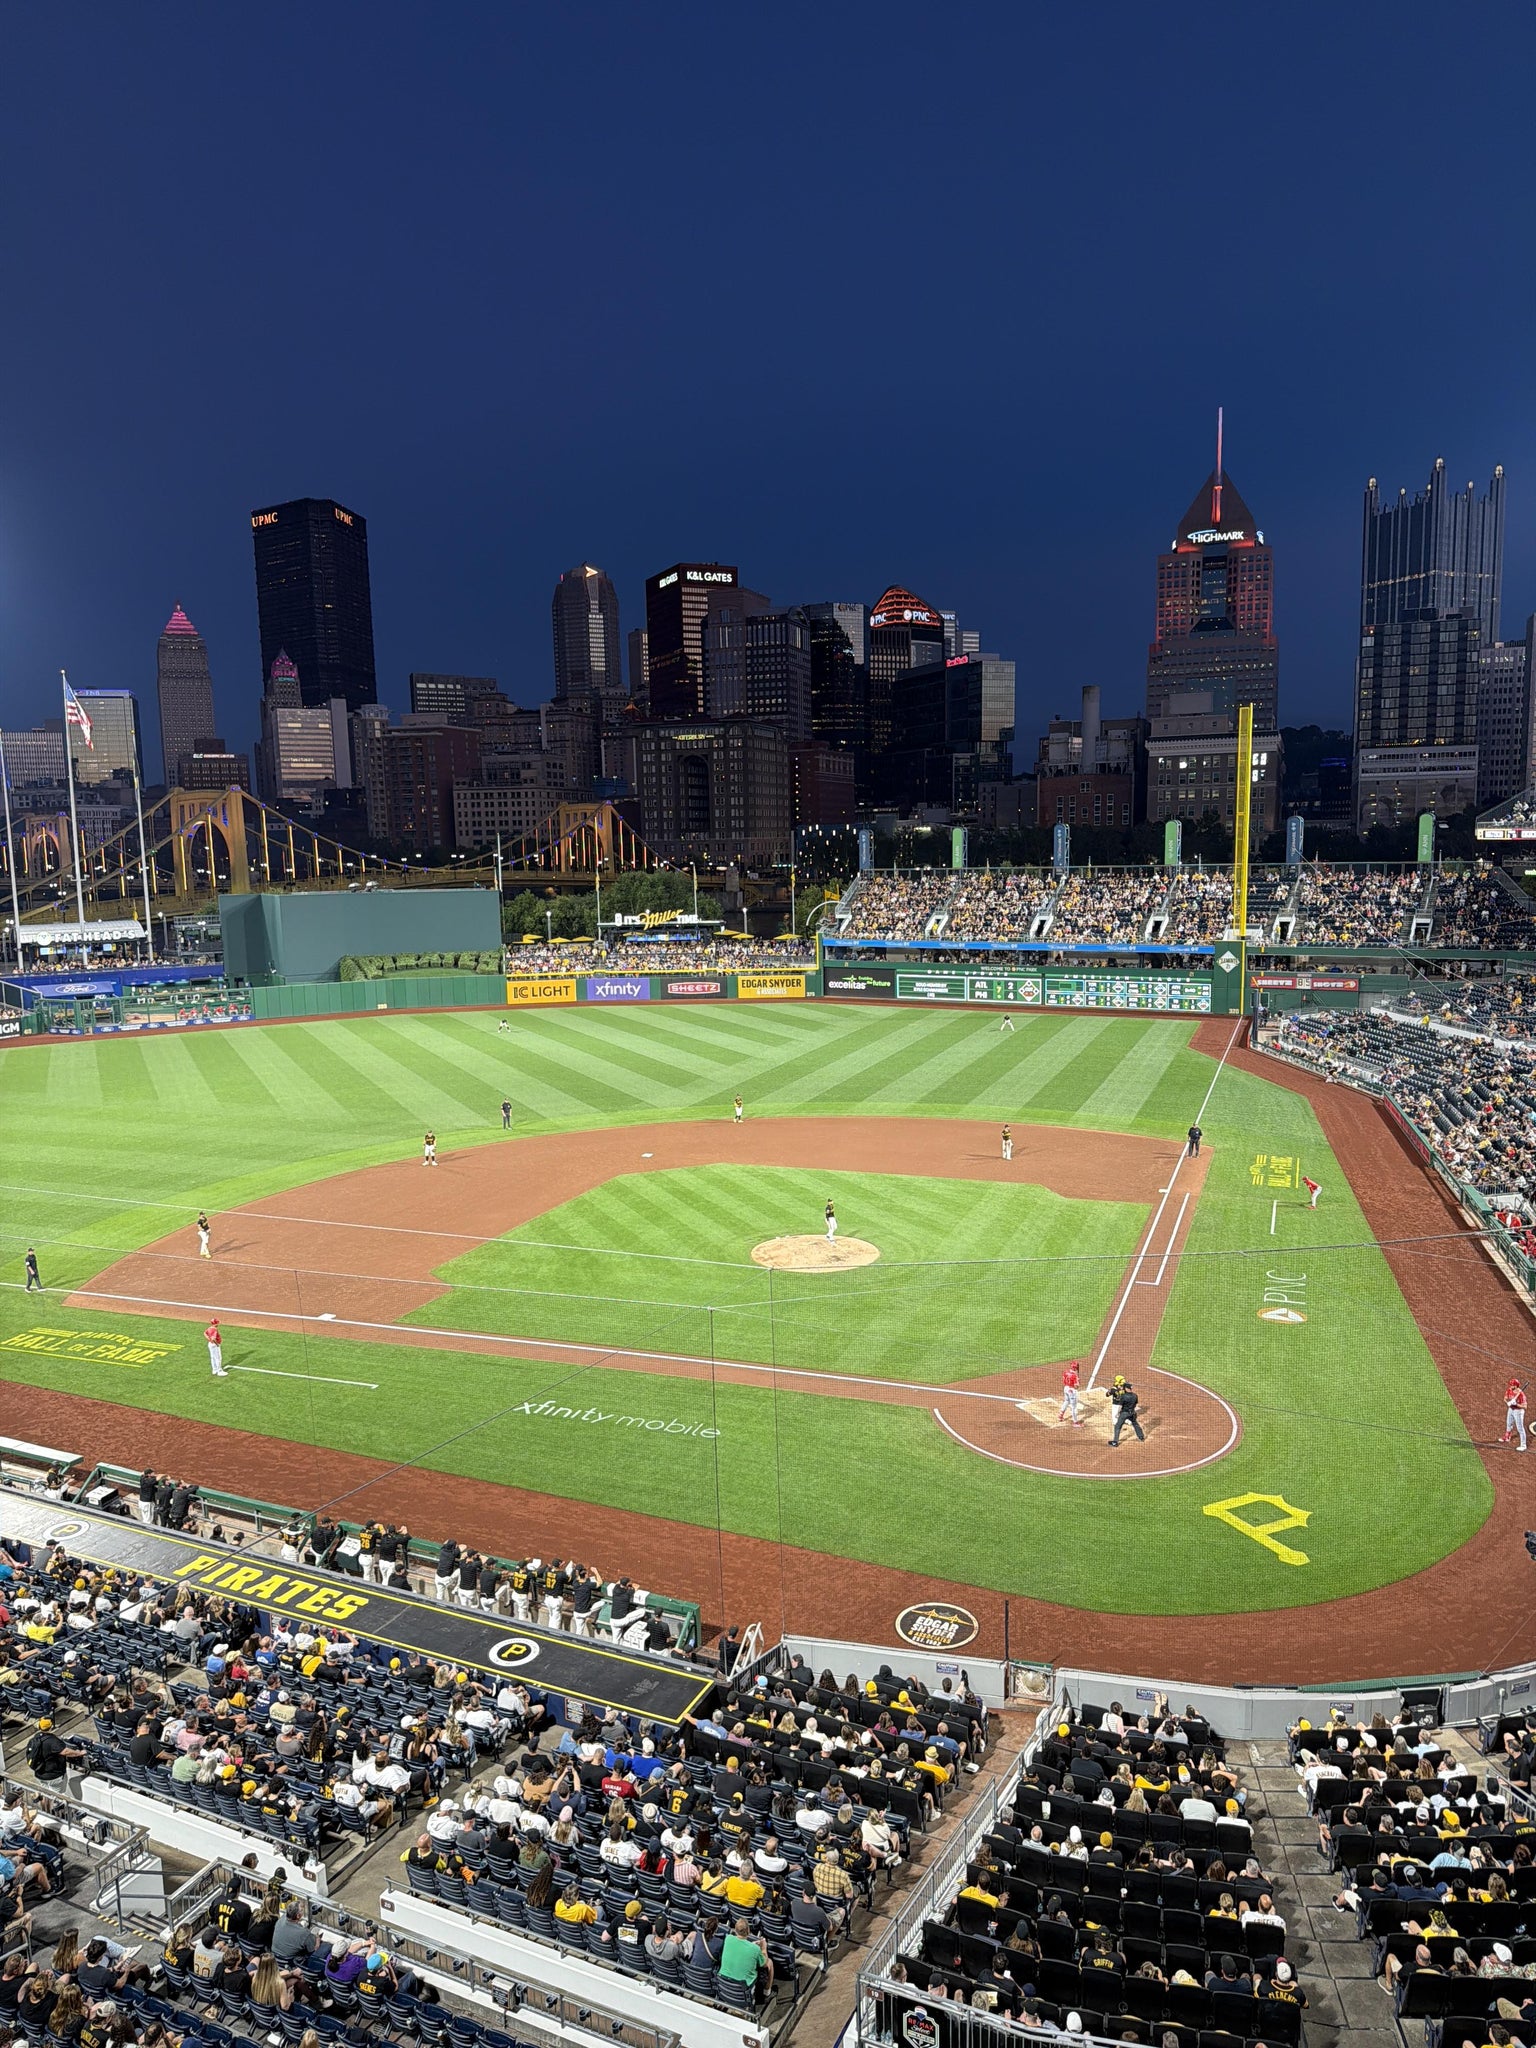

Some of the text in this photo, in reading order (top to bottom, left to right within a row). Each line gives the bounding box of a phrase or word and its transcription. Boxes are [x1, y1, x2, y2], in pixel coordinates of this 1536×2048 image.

[251, 512, 278, 528] UPMC
[335, 507, 353, 527] UPMC
[686, 571, 732, 583] K&L GATES
[875, 612, 887, 623] PNC
[913, 610, 930, 621] PNC
[639, 909, 683, 930] Miller
[677, 914, 700, 924] TIME
[55, 930, 135, 942] FAT HEAD'S
[63, 984, 89, 992] Ford
[595, 982, 641, 997] xfinity
[672, 983, 717, 992] SHEETZ
[741, 978, 802, 988] EDGAR SNYDER
[828, 979, 867, 990] excelitas
[975, 981, 1014, 990] ATL 2
[513, 985, 570, 998] IC LIGHT
[975, 991, 1014, 1000] PHI 4
[1263, 1270, 1307, 1305] PNC
[73, 1331, 135, 1346] PIRATES
[0, 1333, 169, 1364] HALL OF FAME
[513, 1400, 721, 1438] xfinity mobile
[173, 1555, 369, 1620] PIRATES
[911, 1623, 956, 1640] SNYDER
[915, 1616, 960, 1633] EDGAR
[501, 1643, 527, 1658] P
[163, 1729, 171, 1742] 6
[671, 1797, 682, 1814] 6
[218, 1915, 230, 1932] 11
[1092, 1958, 1115, 1970] GRIFFIN
[746, 2038, 757, 2047] 20
